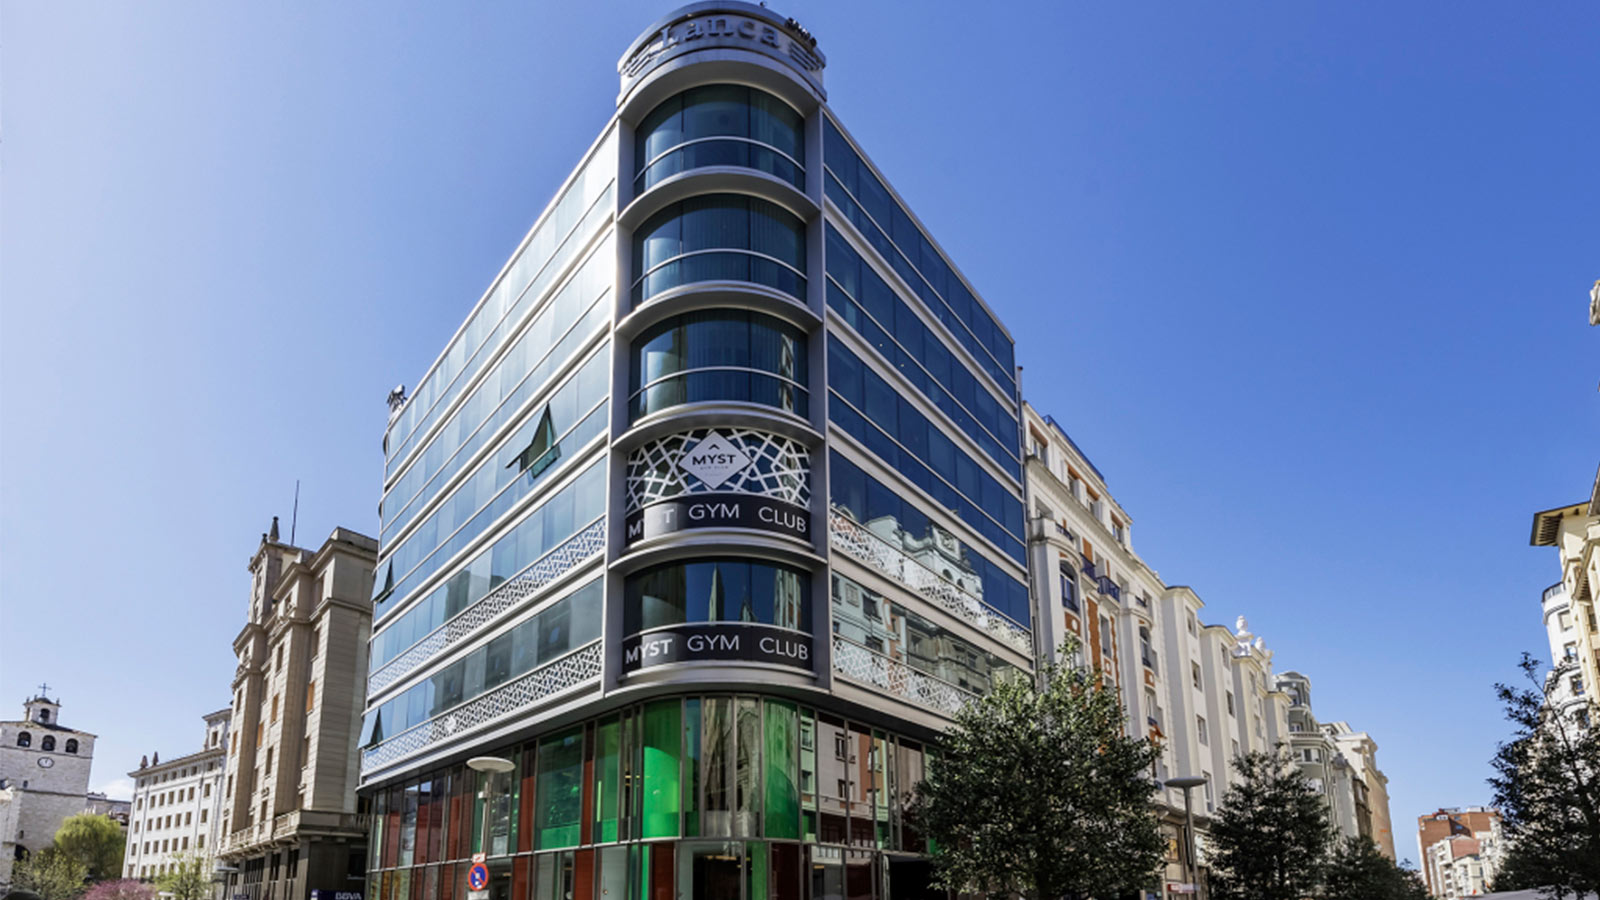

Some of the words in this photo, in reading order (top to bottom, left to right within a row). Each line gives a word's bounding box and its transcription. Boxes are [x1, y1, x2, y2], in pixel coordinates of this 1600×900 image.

[692, 454, 736, 465] MYST
[688, 504, 740, 519] GYM
[758, 507, 806, 532] CLUB
[625, 638, 673, 664] MYST
[686, 635, 740, 651] GYM
[759, 637, 809, 660] CLUB
